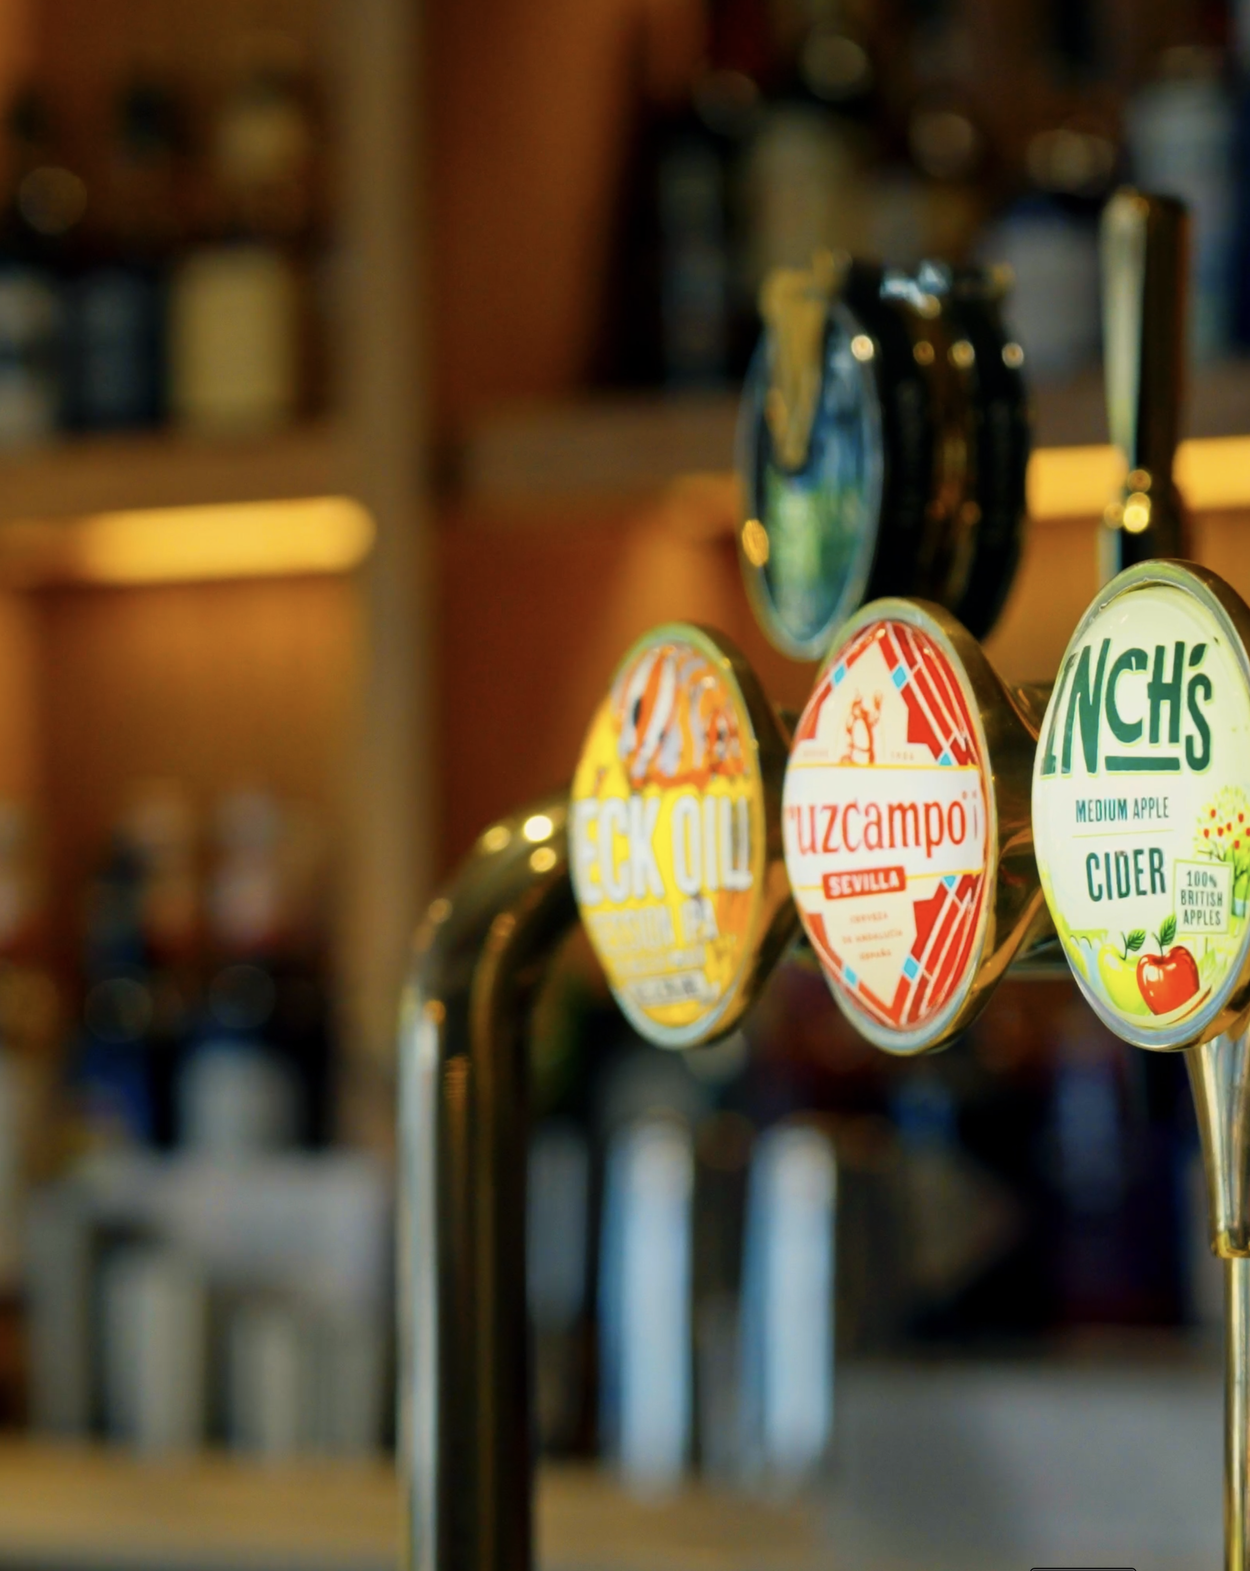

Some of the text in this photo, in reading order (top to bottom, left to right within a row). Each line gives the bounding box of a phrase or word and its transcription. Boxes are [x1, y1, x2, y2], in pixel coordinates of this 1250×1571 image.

[1075, 797, 1169, 822] MEDIUM APPLE
[828, 870, 900, 897] SEVILLA
[1086, 847, 1166, 902] CIDER
[1186, 870, 1218, 888] 100%
[1181, 889, 1223, 906] BRITISH
[1183, 909, 1221, 926] APPLES
